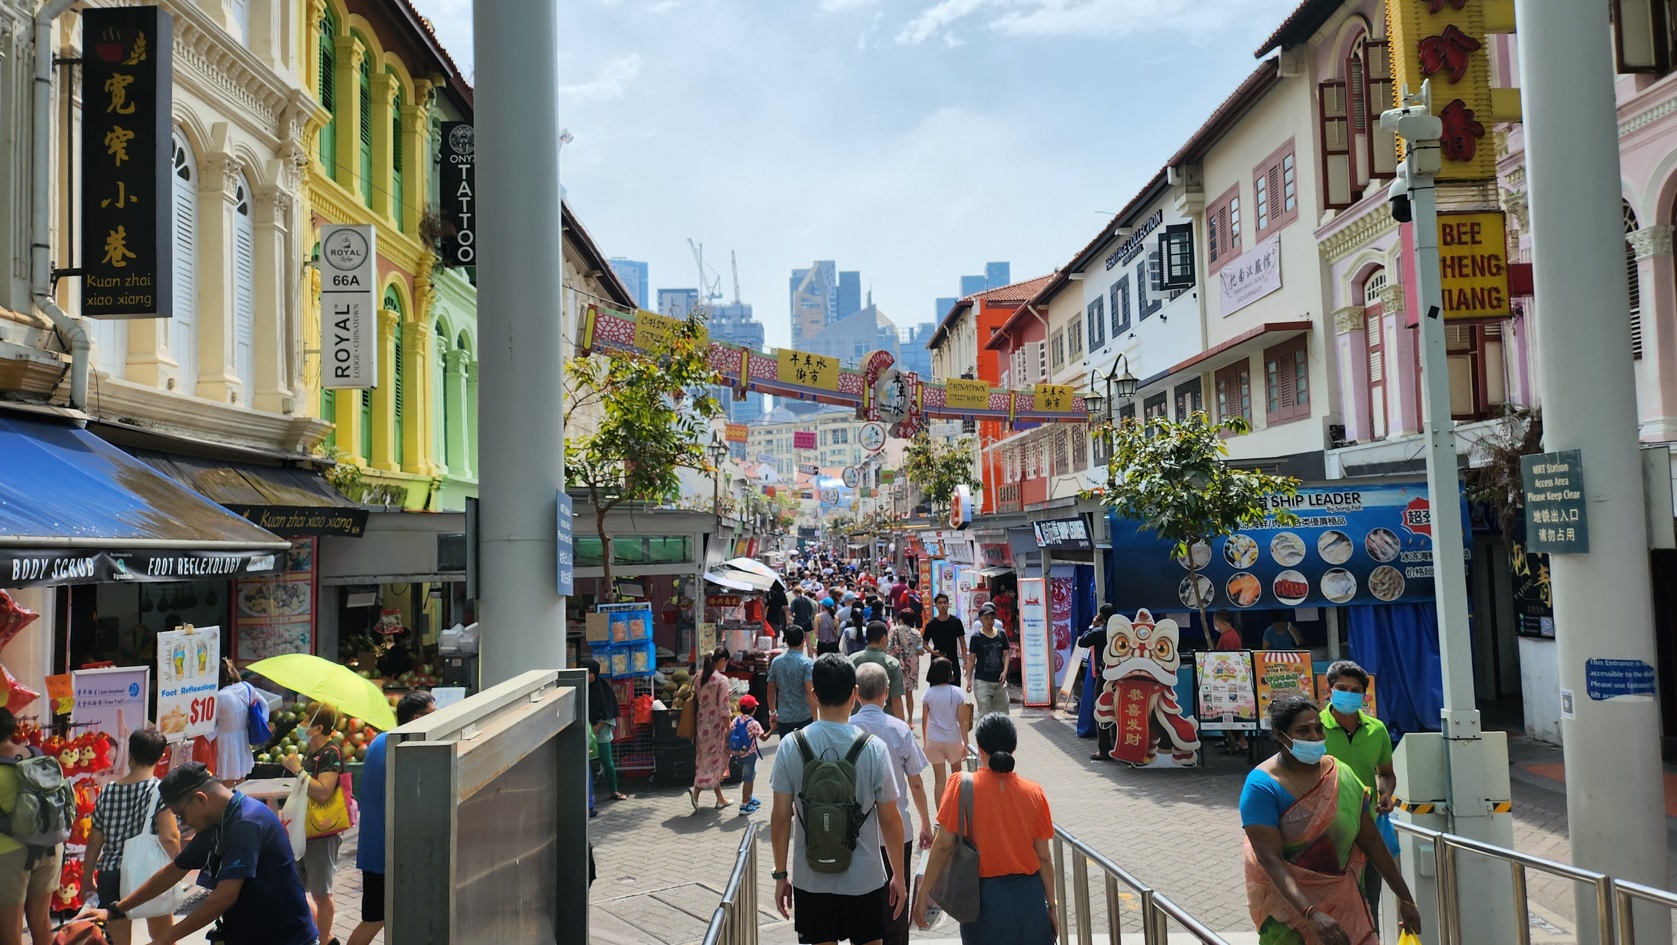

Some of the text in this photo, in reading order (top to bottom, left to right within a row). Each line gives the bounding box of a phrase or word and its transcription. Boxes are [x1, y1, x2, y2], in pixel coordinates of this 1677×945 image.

[457, 164, 473, 262] TATTOO
[1442, 222, 1482, 246] BEE
[1442, 254, 1501, 278] HENG
[86, 272, 151, 288] Kuan zhai
[333, 275, 360, 286] 66A
[86, 291, 152, 307] xiao xiang
[335, 304, 350, 378] ROYAL
[948, 382, 986, 392] CHINATOWN
[1532, 463, 1569, 474] MRT Station
[1534, 477, 1569, 488] Access Area
[1271, 492, 1361, 507] SHIP LEADER
[1527, 489, 1580, 502] Please Keep Clear
[260, 509, 286, 528] Kuan
[286, 510, 308, 528] zhai
[308, 511, 325, 528] xiao
[326, 512, 353, 532] xiang
[1533, 508, 1579, 523] 地铁出入口
[1538, 527, 1575, 542] 请勿占用
[12, 557, 94, 580] BODY SCRUB
[148, 557, 174, 575] FOOT
[177, 556, 241, 575] REFLEXOLOGY
[161, 683, 217, 697] Foot Reflexology
[190, 696, 215, 726] $10
[1124, 688, 1144, 746] 恭喜发财
